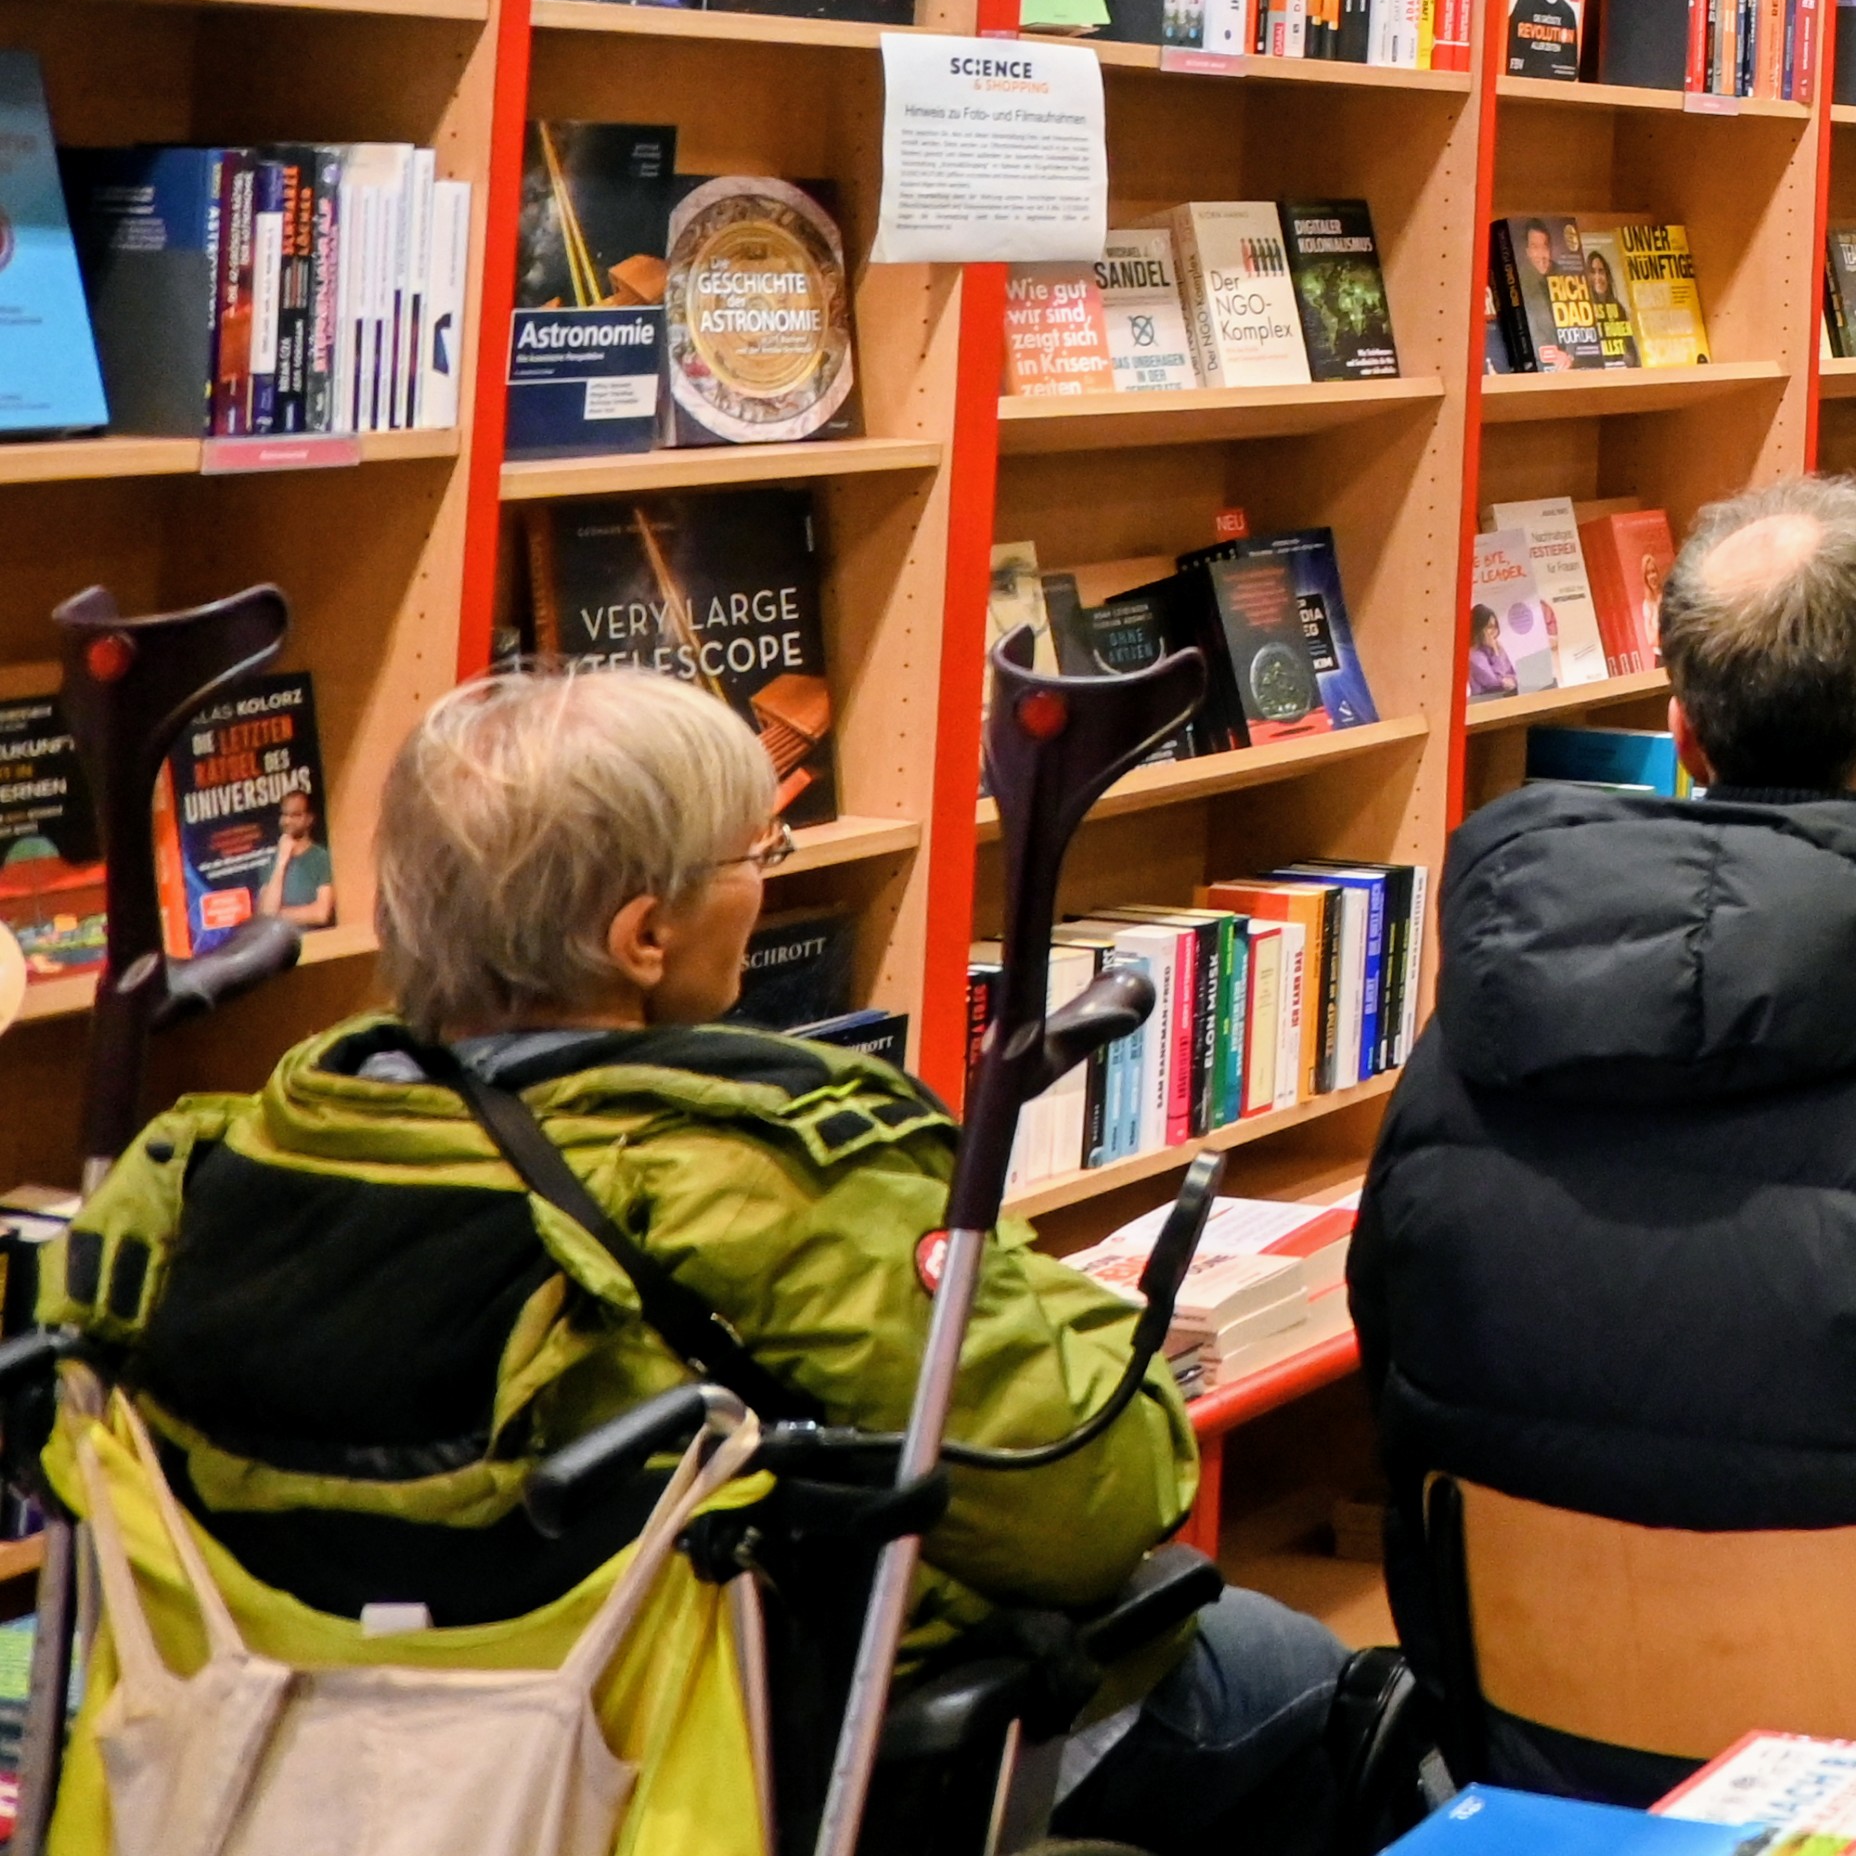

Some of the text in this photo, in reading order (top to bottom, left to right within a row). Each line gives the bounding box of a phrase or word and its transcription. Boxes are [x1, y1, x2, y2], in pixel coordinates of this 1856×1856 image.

[985, 80, 1050, 95] SHOPPING
[904, 104, 1087, 126] Hinweis zu Foto- und Filmaufnahmen
[1294, 220, 1342, 235] DIGITALER
[1622, 225, 1671, 253] UNVER
[1298, 237, 1373, 253] KOLONIALISMUS
[1094, 261, 1170, 290] SANDEL
[1627, 254, 1695, 281] NÜNFTIGE
[697, 273, 808, 294] GESCHICHTE
[1005, 278, 1088, 305] Wie gut
[1210, 270, 1240, 292] Der
[1547, 275, 1590, 302] RICH
[726, 294, 747, 307] der
[1215, 294, 1272, 316] NGO-
[700, 309, 822, 333] ASTRONOMIE
[1007, 299, 1092, 329] wir sind,
[1552, 302, 1594, 328] DAD
[517, 316, 655, 349] Astronomie
[1012, 324, 1097, 353] zeigt sich
[1220, 317, 1293, 345] Komplex
[1557, 328, 1598, 344] POOR DAD
[1016, 350, 1109, 375] in Krisen-
[1206, 349, 1219, 372] Der
[1021, 375, 1082, 396] zeiten
[1216, 514, 1245, 532] NEU
[1483, 551, 1511, 567] BYE,
[1558, 560, 1581, 573] Frauen
[1481, 565, 1526, 584] LEADER
[580, 587, 800, 641] VERY LARGE
[1108, 629, 1144, 647] OHNE
[1313, 655, 1333, 670] KIM
[236, 688, 304, 715] KOLORZ
[191, 714, 294, 756] DIE LETZTEN
[264, 748, 291, 774] DES
[184, 765, 312, 825] UNIVERSUMS
[1291, 951, 1304, 1028] ICH KANN DAS
[1203, 953, 1219, 1069] ELON MUSK
[1157, 965, 1172, 1110] SAM BANKMAN-FRIED
